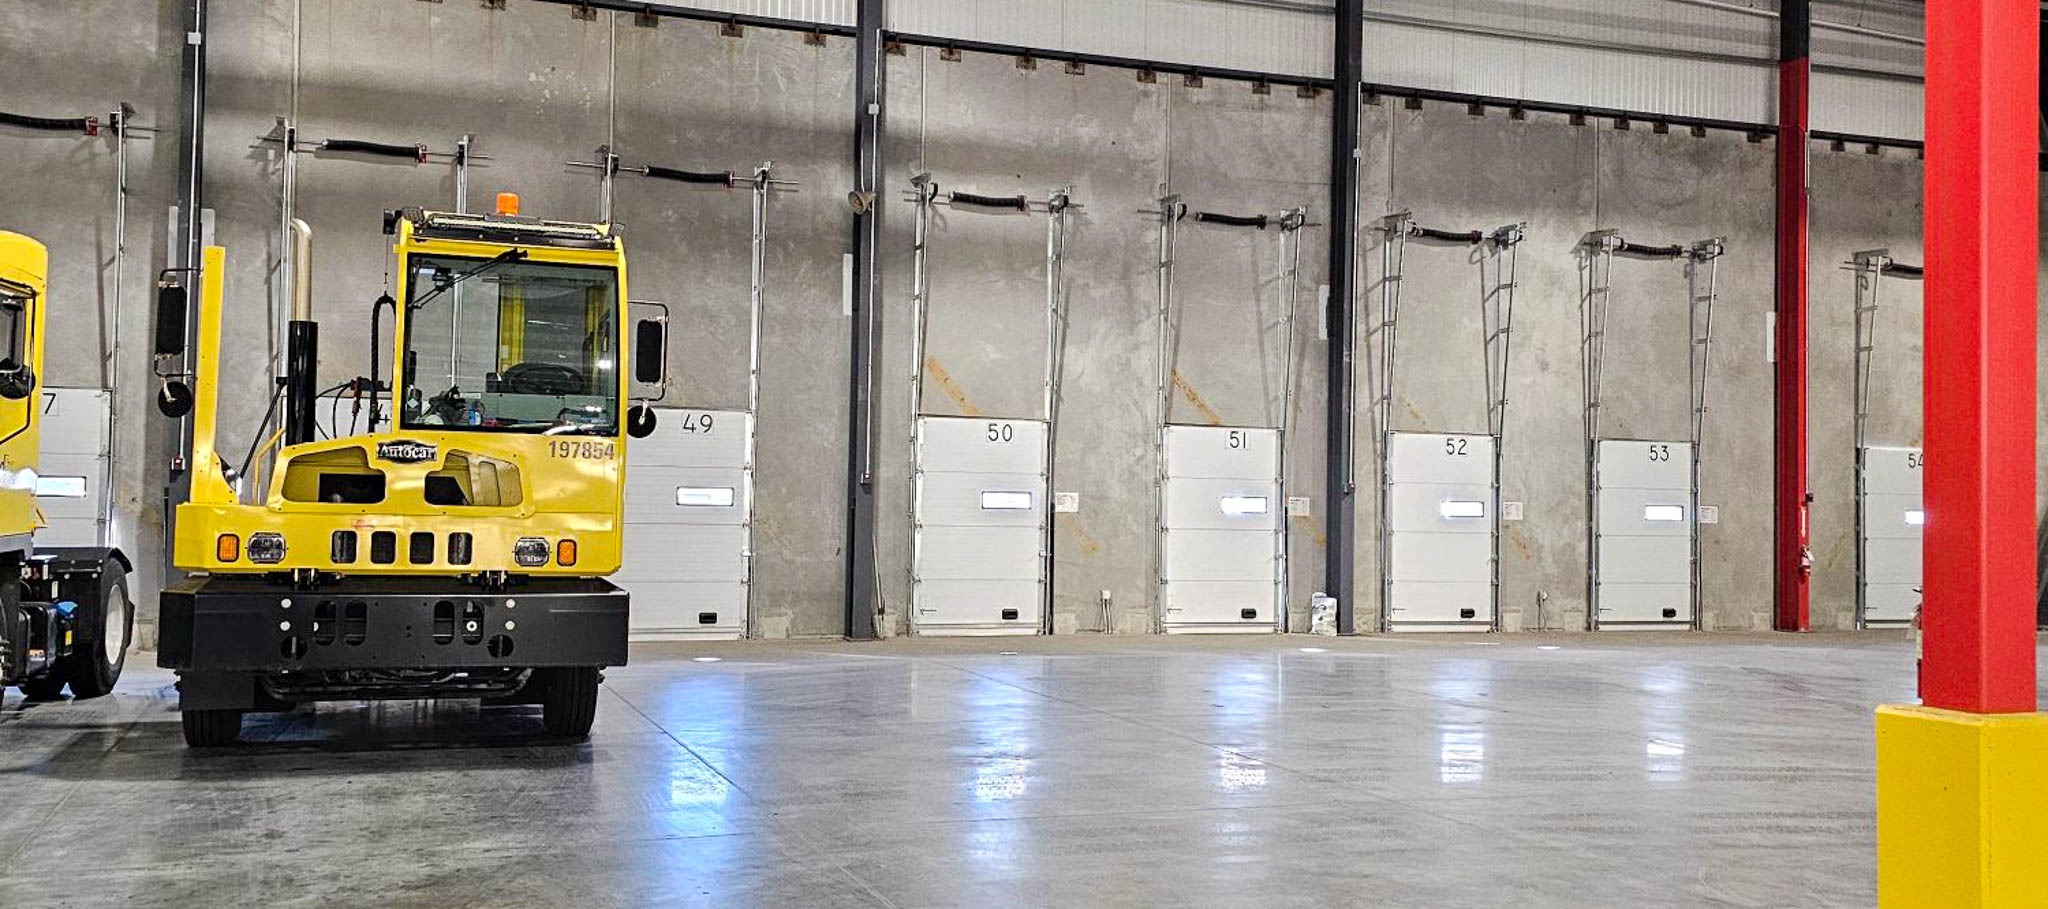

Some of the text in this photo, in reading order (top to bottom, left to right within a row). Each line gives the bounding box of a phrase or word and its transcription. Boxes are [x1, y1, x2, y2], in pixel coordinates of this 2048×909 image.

[683, 414, 713, 434] 49
[987, 423, 1013, 442] 50
[1229, 431, 1247, 449] 51
[1445, 438, 1468, 456] 52
[380, 444, 433, 458] Autocar
[548, 440, 615, 460] 197854
[1648, 445, 1670, 462] 53
